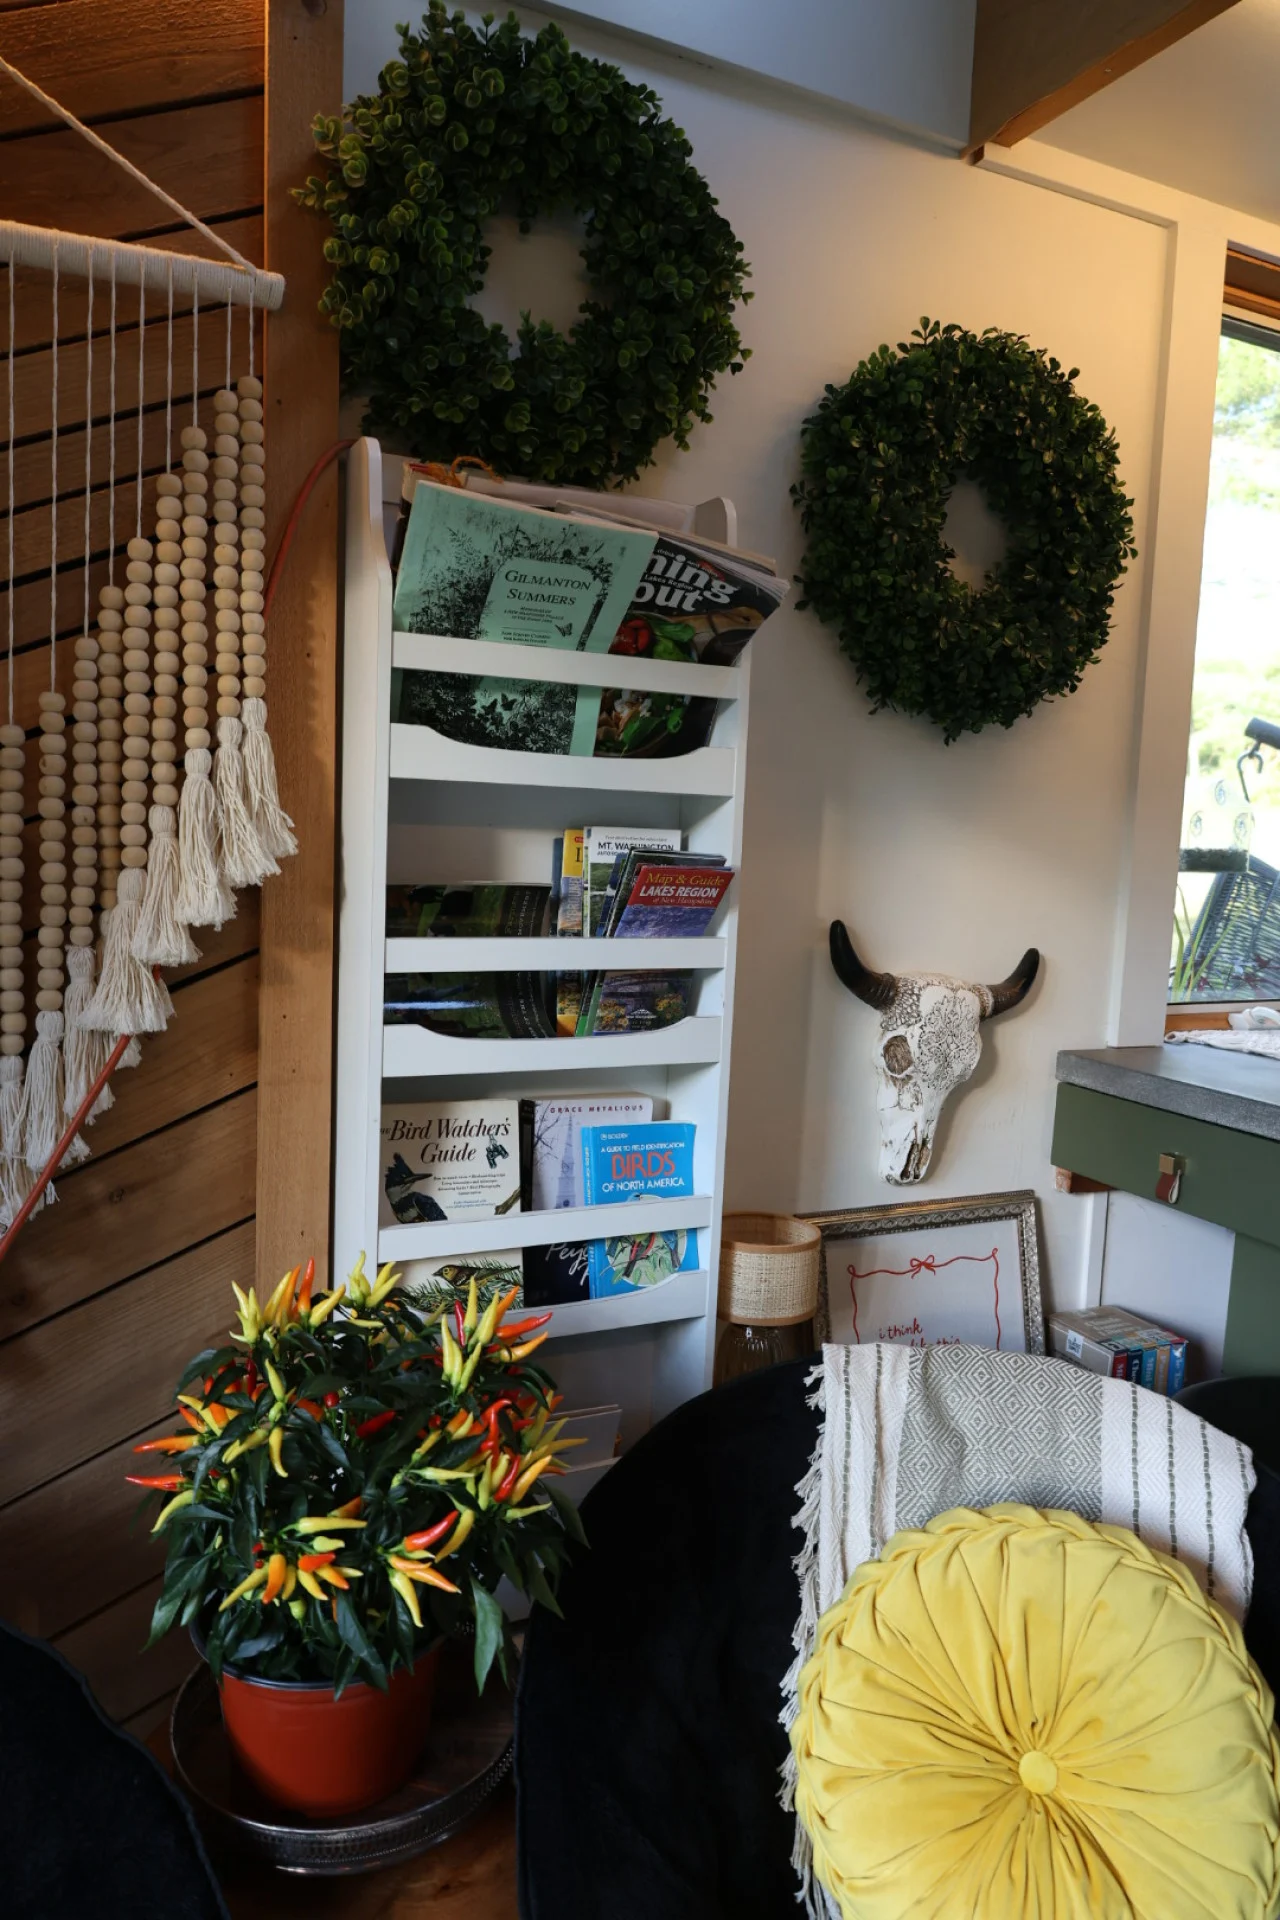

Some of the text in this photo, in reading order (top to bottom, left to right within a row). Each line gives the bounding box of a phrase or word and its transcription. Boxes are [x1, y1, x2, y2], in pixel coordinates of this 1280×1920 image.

[505, 569, 591, 591] GILMANTON
[667, 579, 693, 591] Region
[507, 588, 576, 605] SUMMERS
[598, 842, 613, 850] MT.
[646, 871, 725, 886] Map & Guide
[639, 885, 719, 898] LAKES REGION
[588, 1104, 644, 1112] METALIOUS
[387, 1119, 433, 1141] Bird
[437, 1117, 512, 1139] Watcher's
[420, 1142, 477, 1164] Guide
[606, 1145, 623, 1153] GUIDE
[623, 1144, 631, 1152] TO
[611, 1150, 676, 1180] BIRDS
[602, 1177, 685, 1192] OF NORTH AMERICA
[887, 1317, 923, 1339] think
